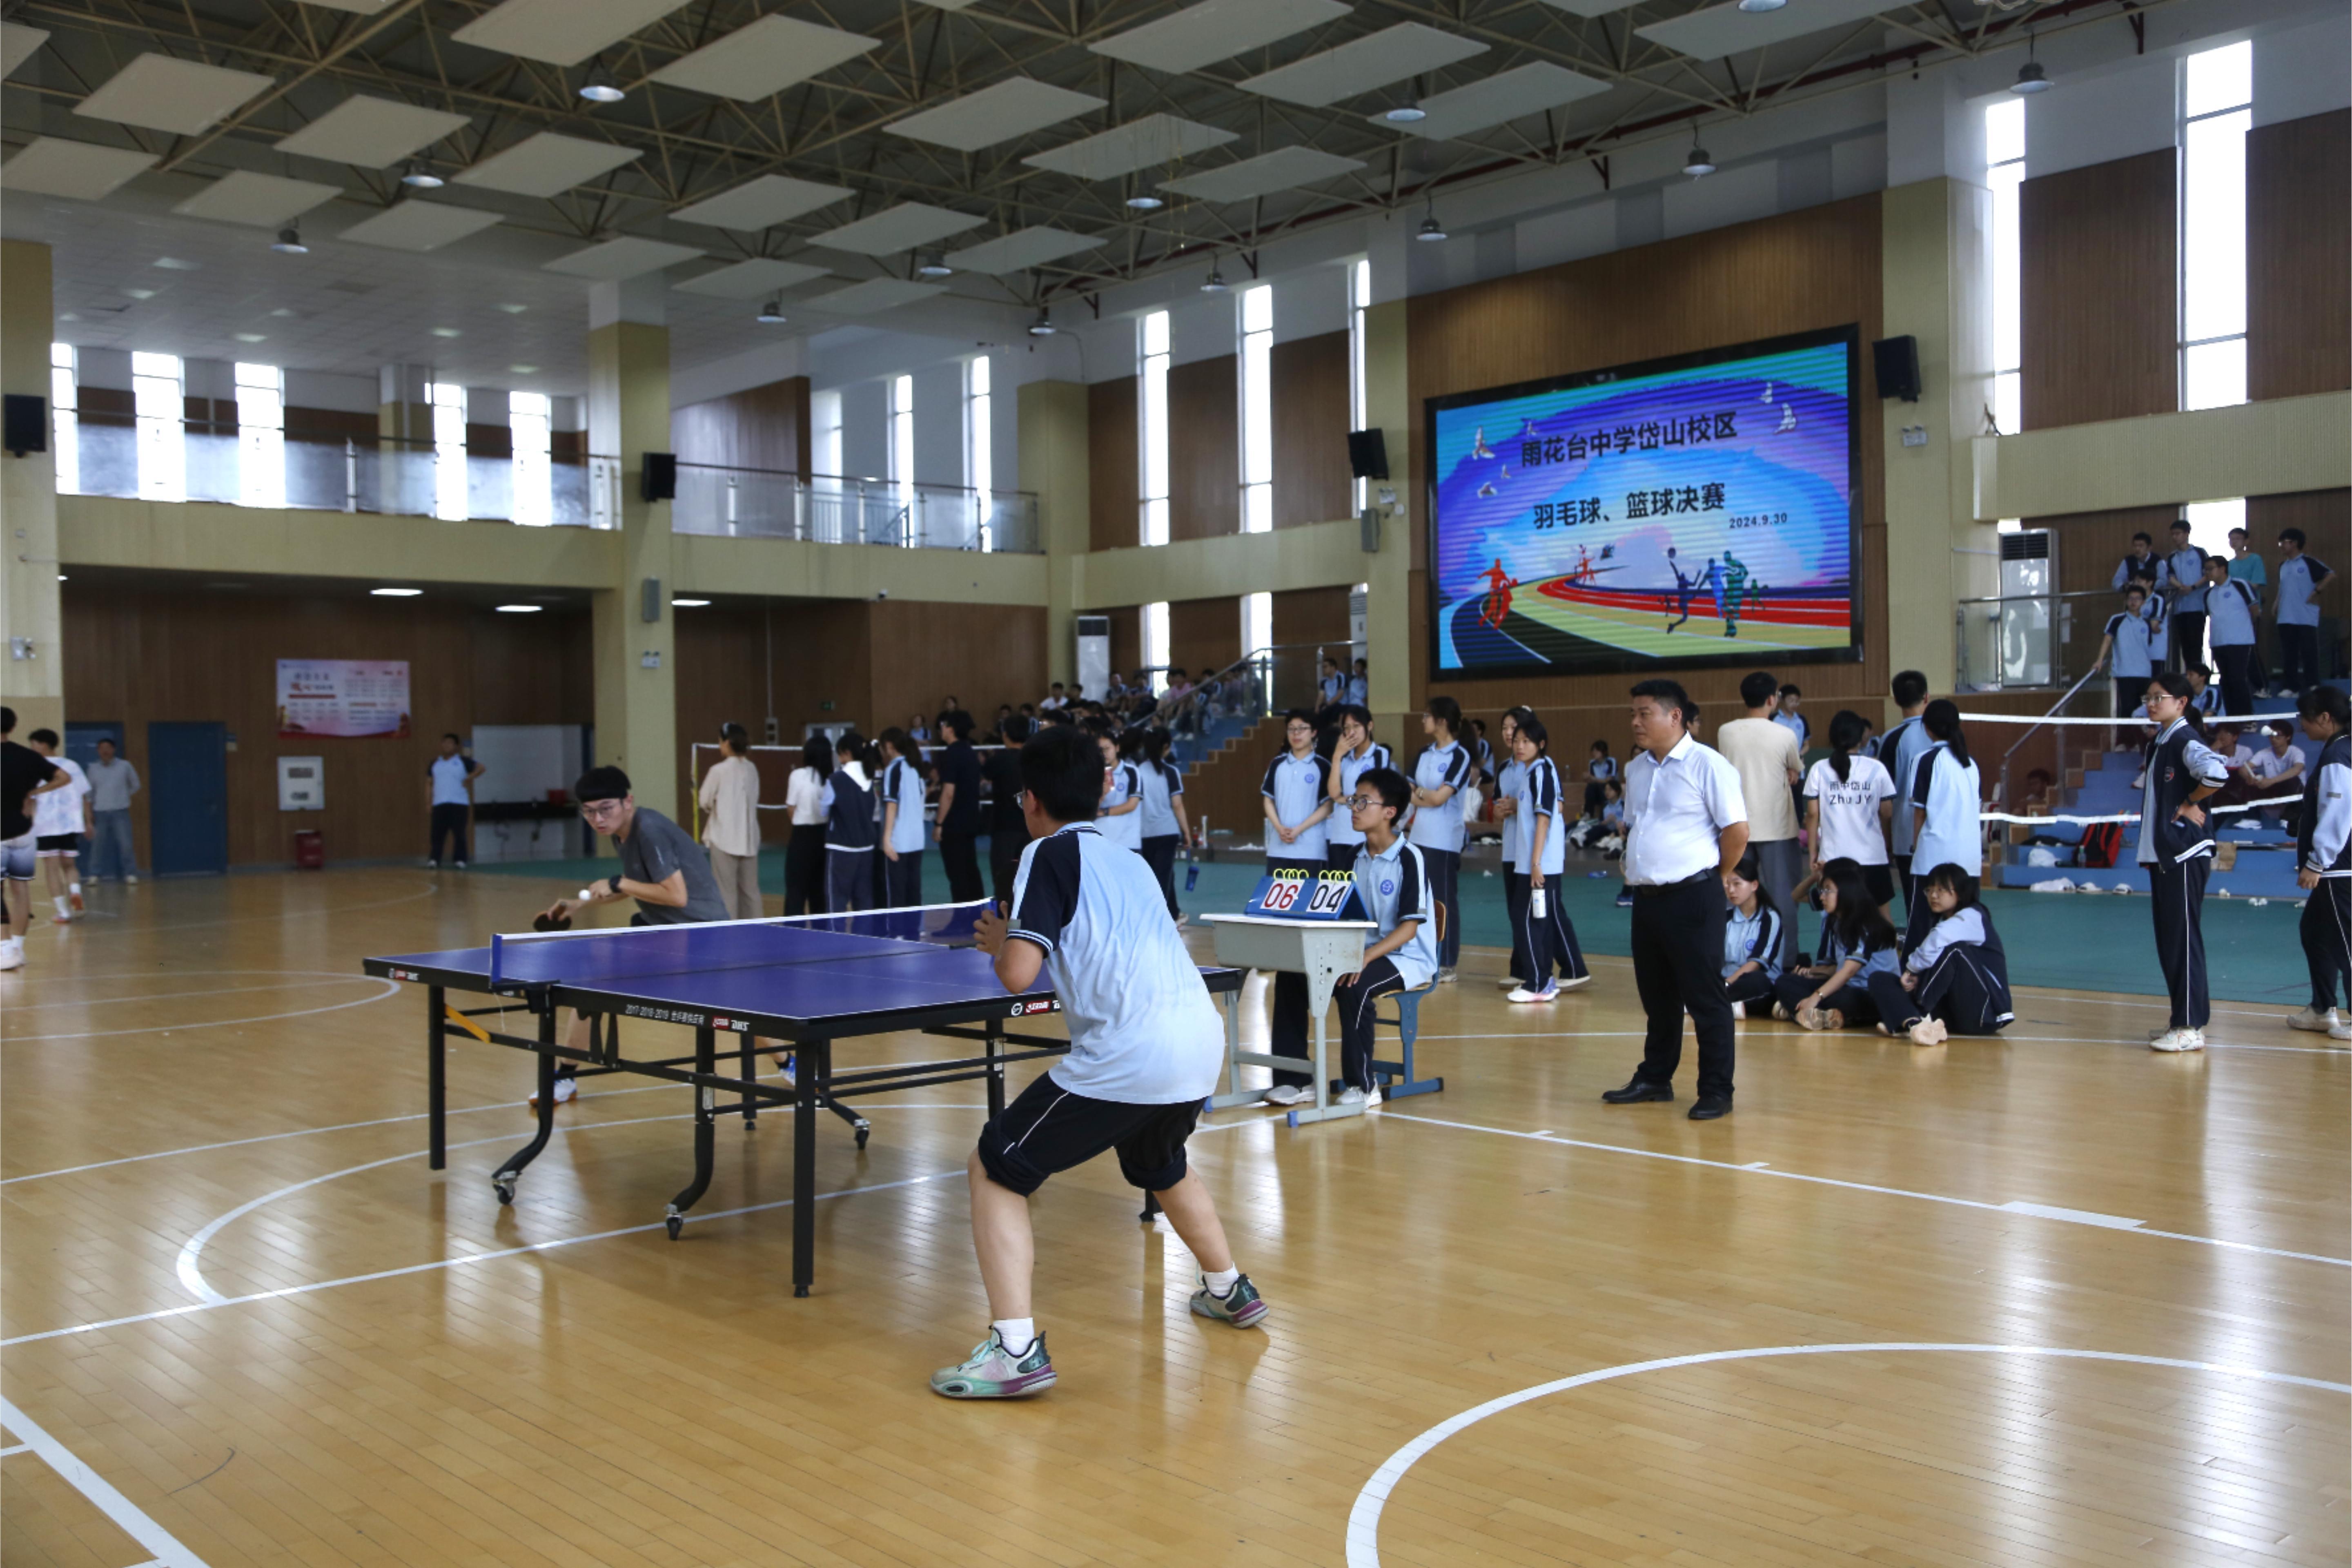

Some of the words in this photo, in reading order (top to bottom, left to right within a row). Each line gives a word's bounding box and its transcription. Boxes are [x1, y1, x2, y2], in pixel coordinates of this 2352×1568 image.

[1521, 411, 1737, 467] 雨花台中学岱山校区
[1533, 482, 1725, 530] 羽毛球、篮球决赛
[1729, 512, 1787, 529] 2024.9.30
[1264, 883, 1298, 909] 06
[1310, 884, 1346, 912] 04
